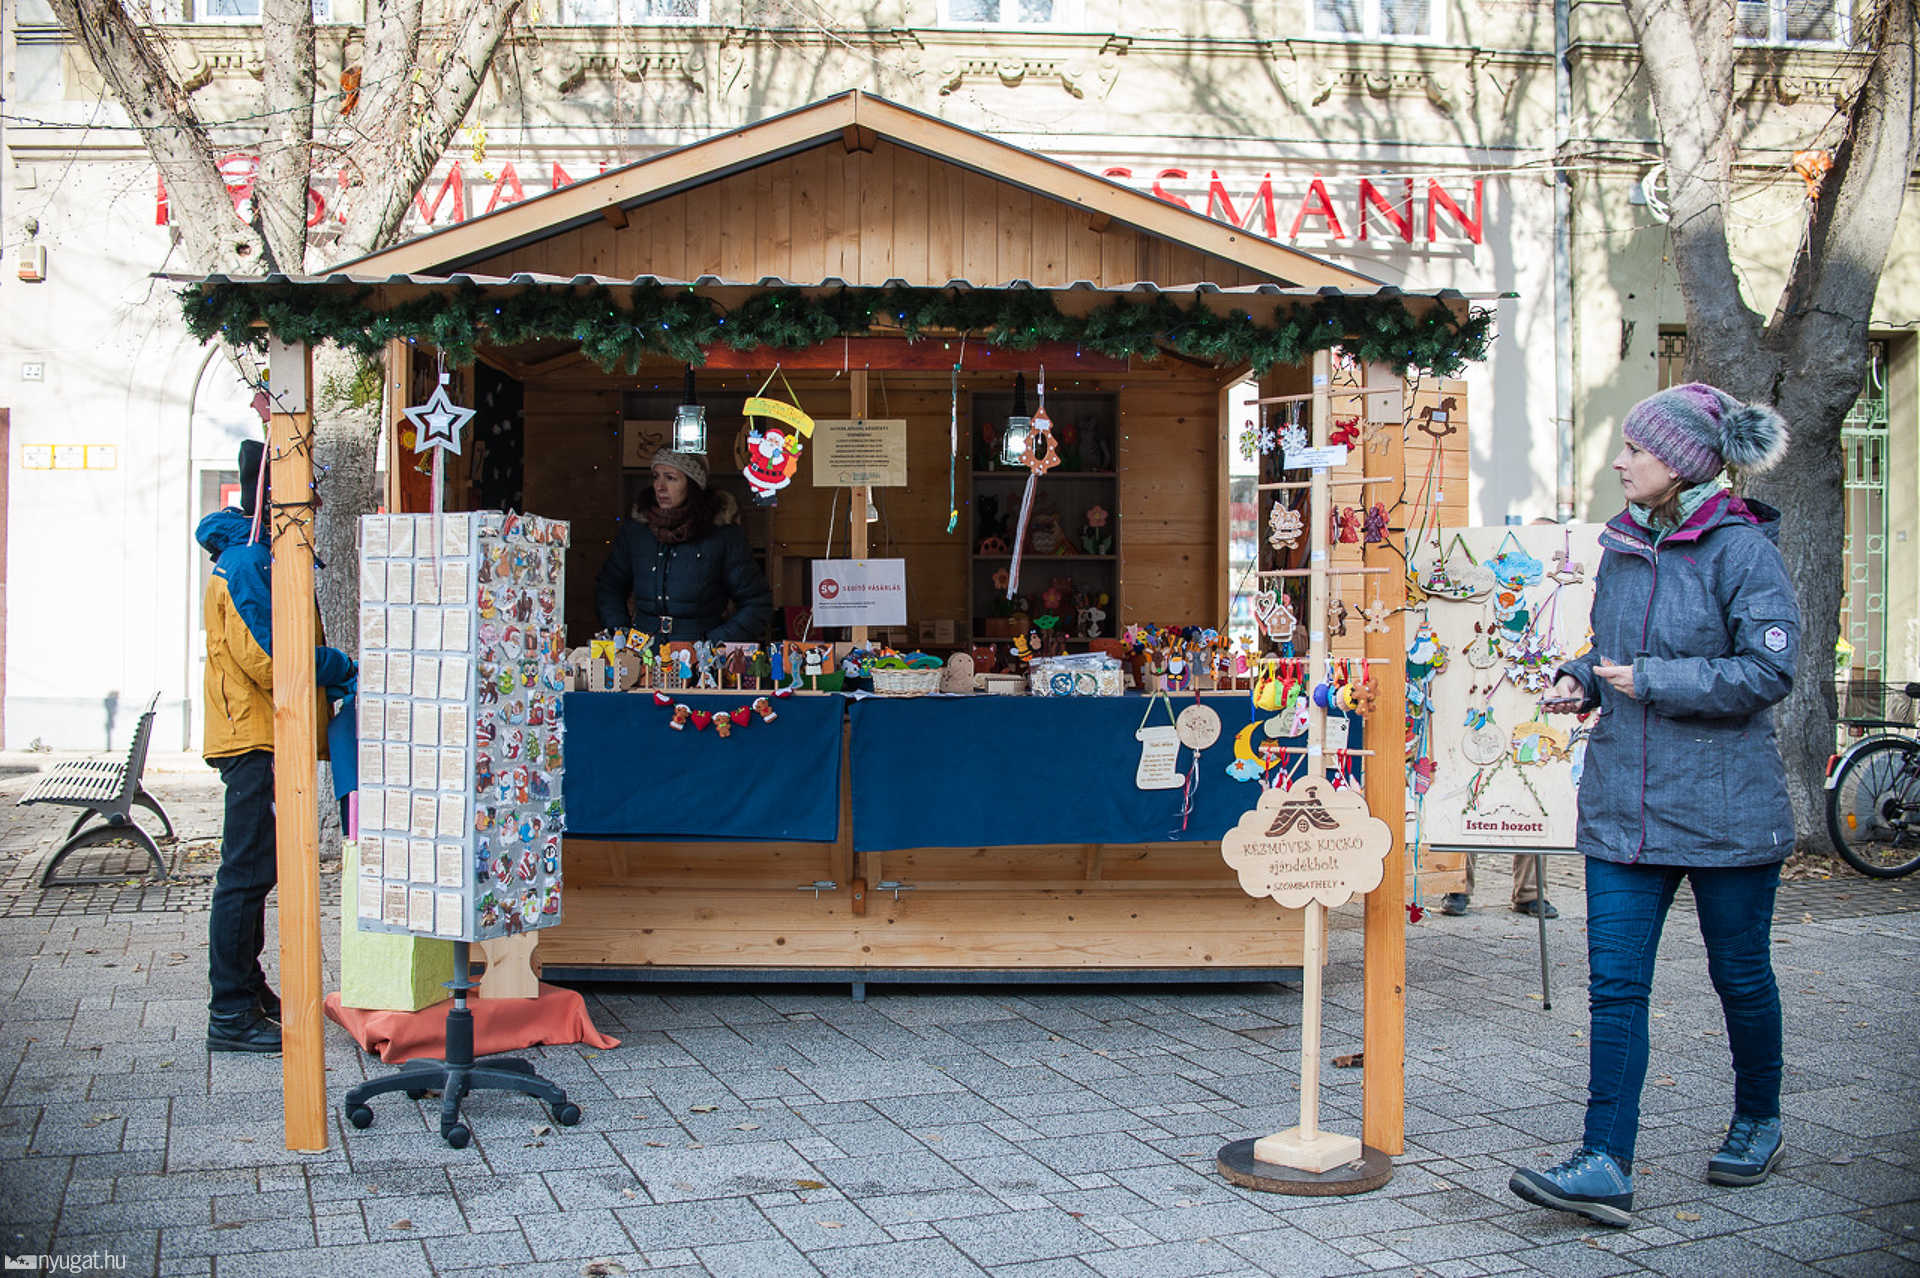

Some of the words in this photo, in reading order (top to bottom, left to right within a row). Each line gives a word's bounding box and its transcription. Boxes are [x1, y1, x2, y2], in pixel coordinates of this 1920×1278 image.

[1466, 819, 1498, 831] Isten
[1501, 820, 1544, 832] hozott
[1273, 880, 1338, 892] SZOMBATHELY
